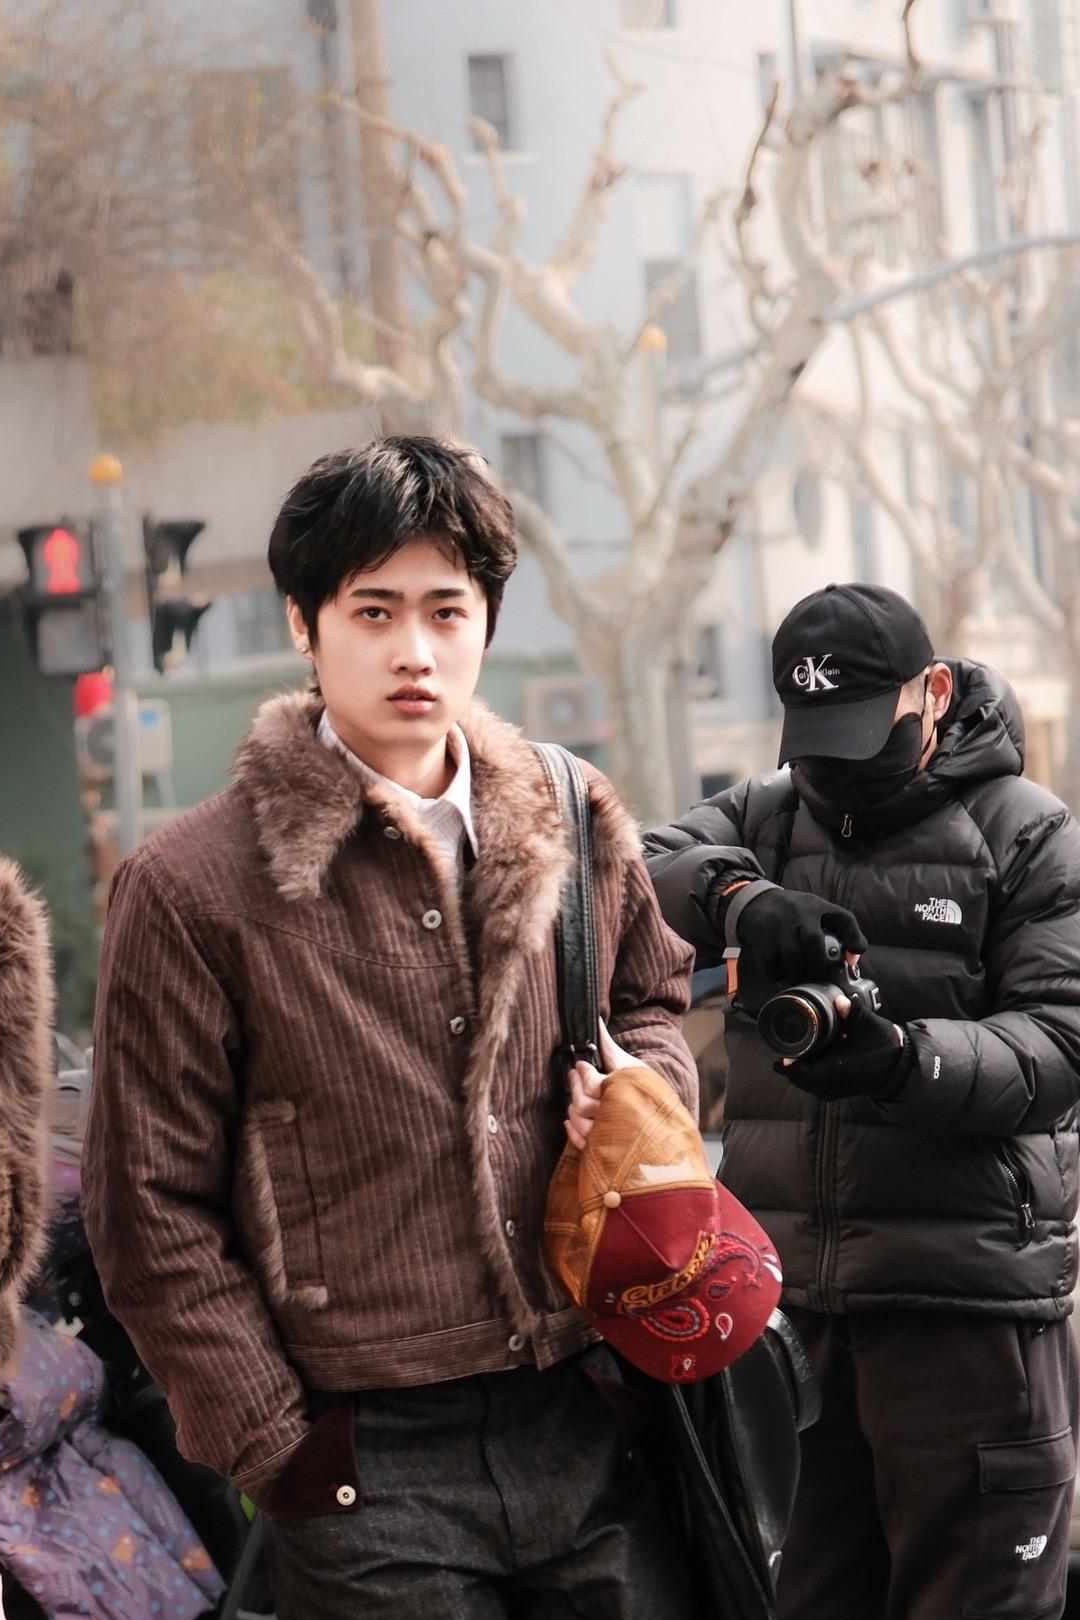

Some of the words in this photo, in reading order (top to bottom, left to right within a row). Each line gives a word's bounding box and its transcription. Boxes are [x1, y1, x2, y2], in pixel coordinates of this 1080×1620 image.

[929, 897, 947, 907] THE
[914, 904, 947, 915] NORTH
[922, 912, 947, 922] FACE
